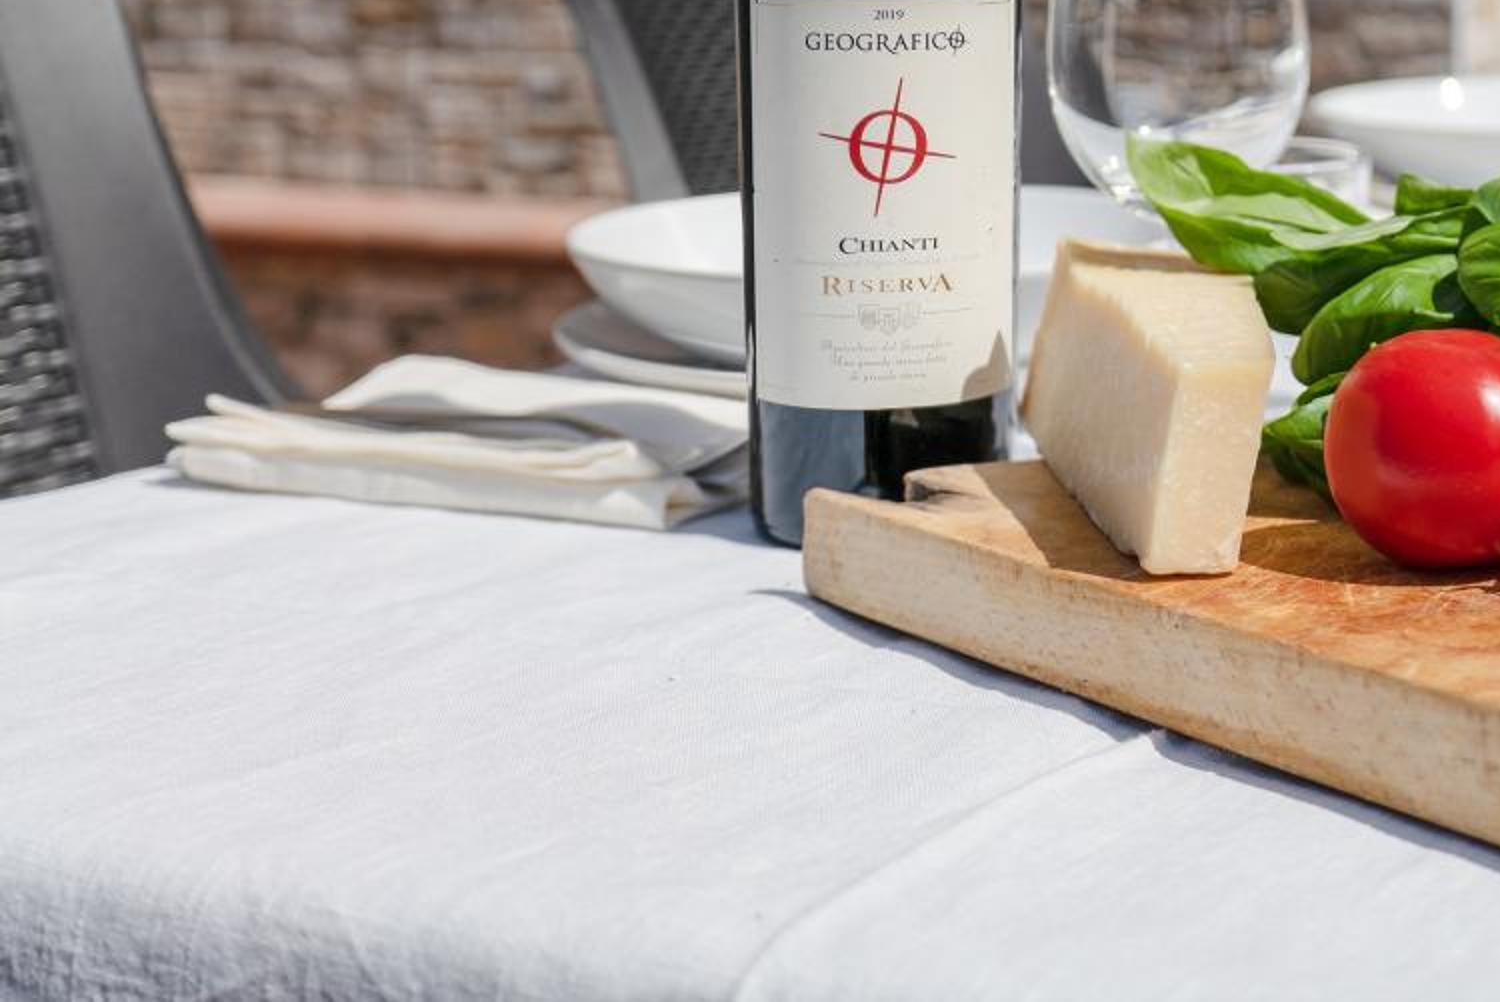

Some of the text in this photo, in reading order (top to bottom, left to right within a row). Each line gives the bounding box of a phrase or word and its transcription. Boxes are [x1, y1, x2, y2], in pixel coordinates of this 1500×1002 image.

[874, 8, 904, 20] 2019
[805, 26, 968, 55] GEOGRAFICO
[838, 237, 938, 255] CHIANTI
[821, 274, 953, 296] RISERVA
